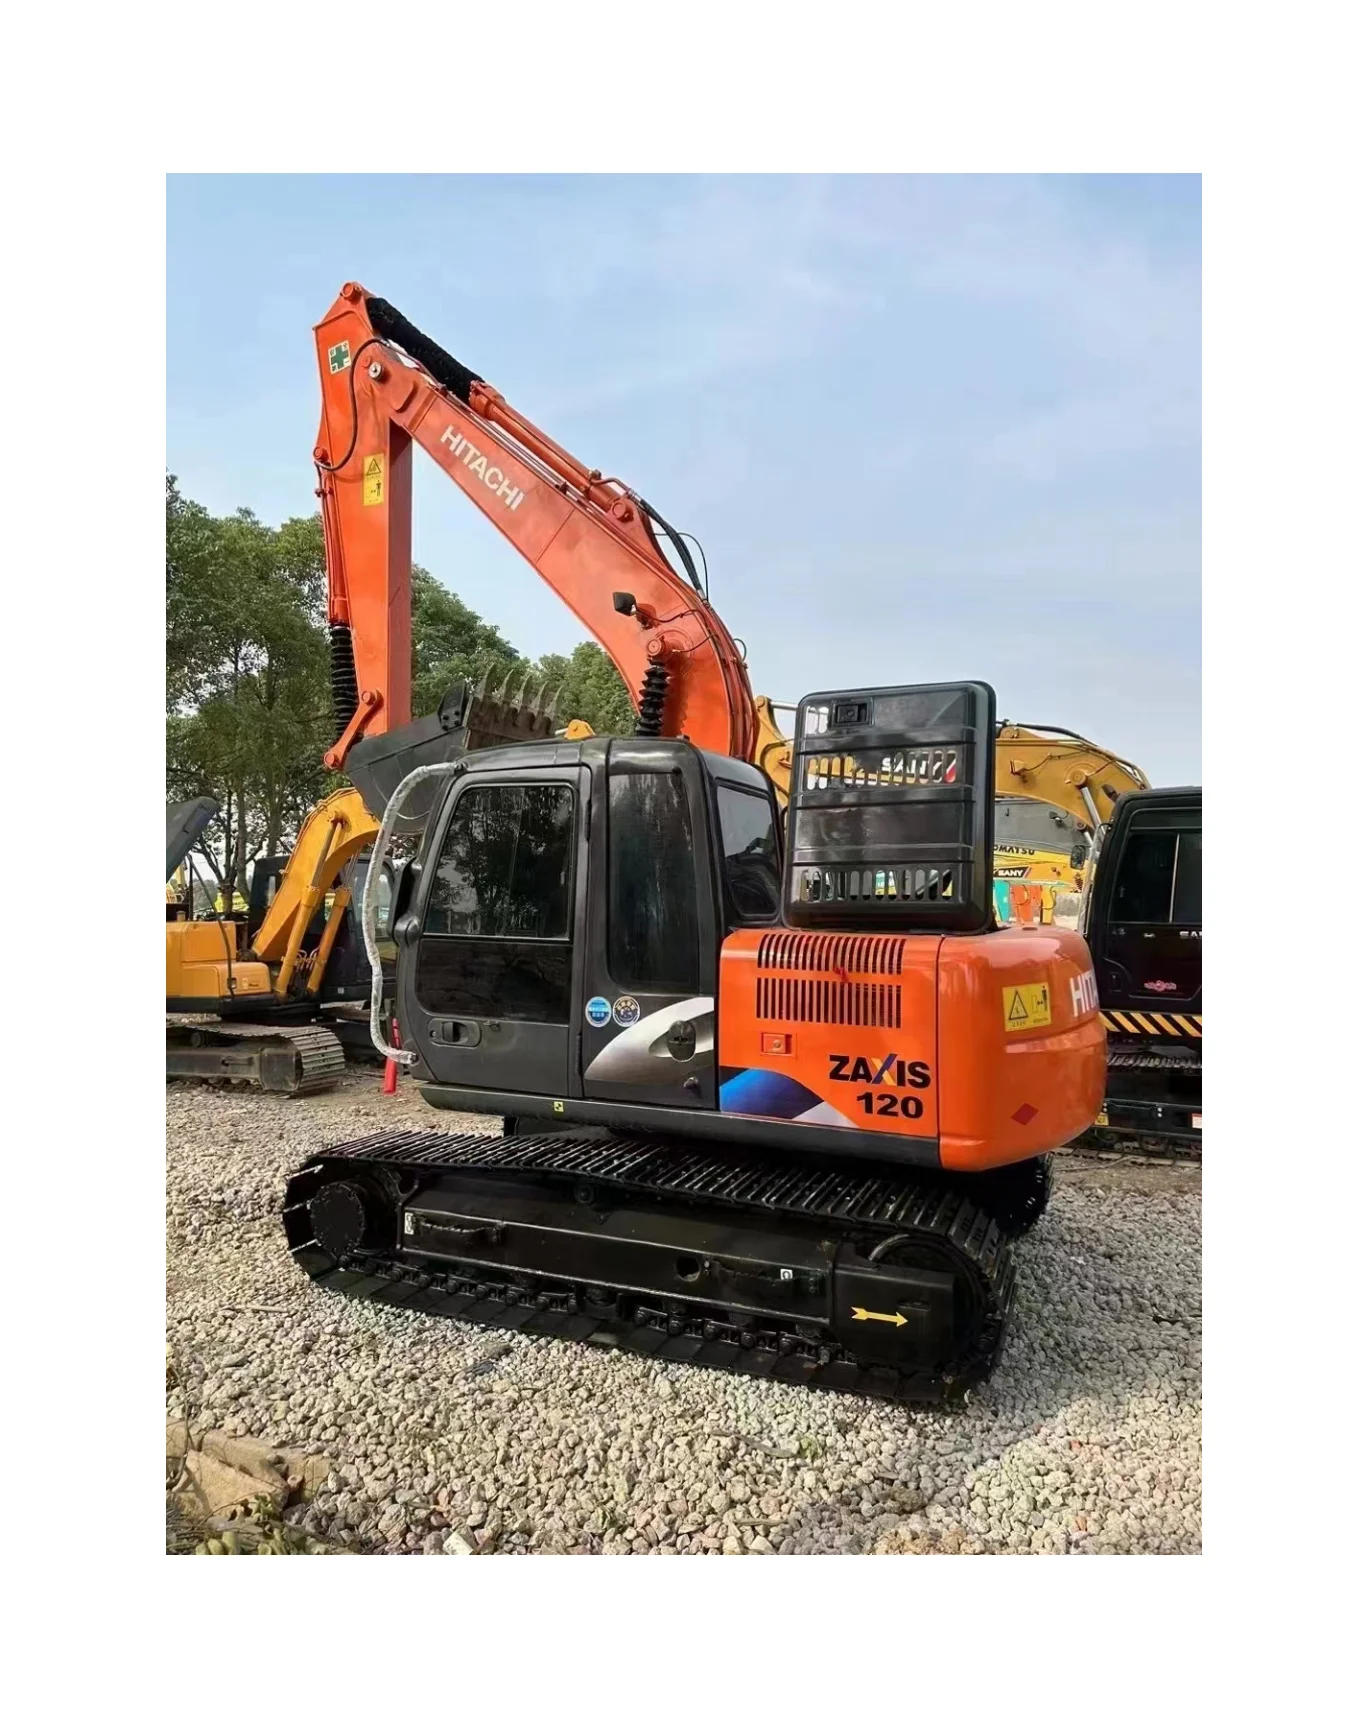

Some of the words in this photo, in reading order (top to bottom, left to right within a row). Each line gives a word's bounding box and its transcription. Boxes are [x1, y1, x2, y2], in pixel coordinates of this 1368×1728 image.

[440, 424, 524, 511] HITACHI
[829, 1053, 931, 1089] ZAXIS
[856, 1092, 924, 1119] 120
